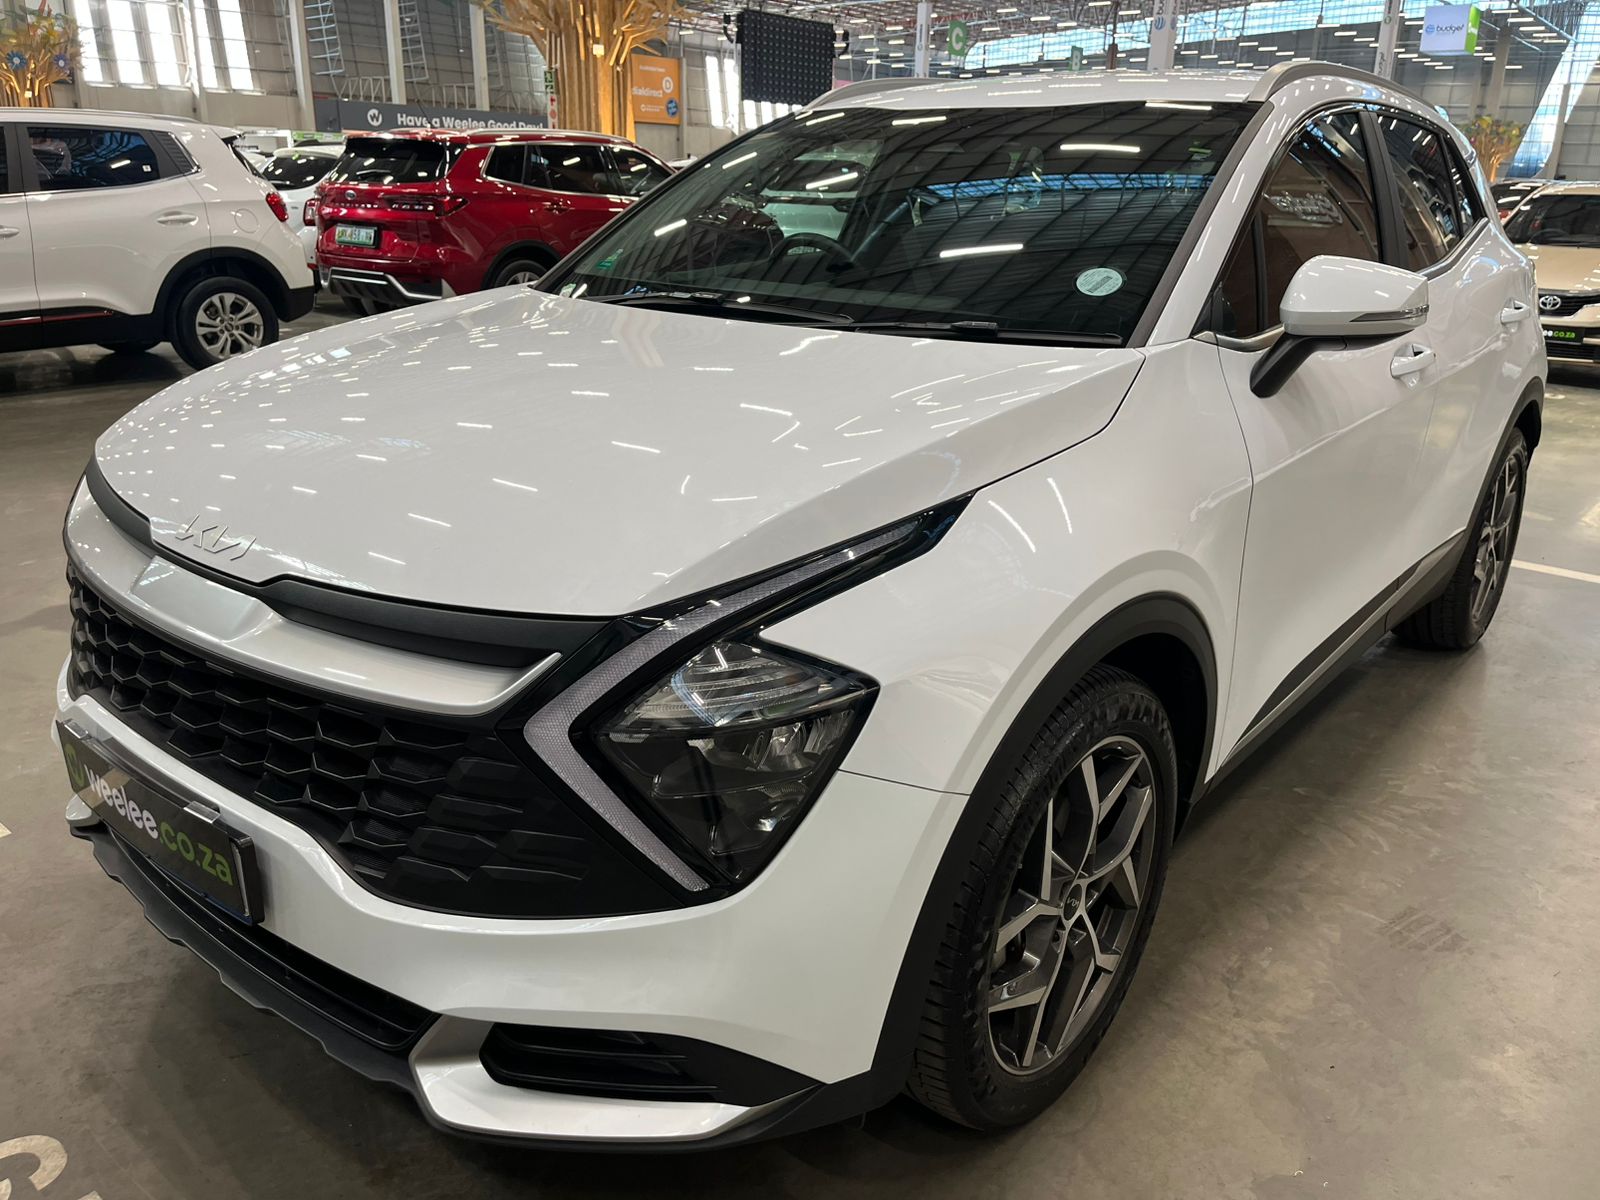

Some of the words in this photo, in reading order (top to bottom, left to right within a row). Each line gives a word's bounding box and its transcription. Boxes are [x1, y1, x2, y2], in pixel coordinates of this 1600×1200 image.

[952, 26, 963, 49] C
[1436, 24, 1464, 34] budget
[1072, 50, 1080, 67] B
[397, 113, 429, 127] Have
[442, 116, 485, 129] Weelee
[487, 119, 516, 129] Good
[175, 513, 257, 562] KIA
[84, 764, 233, 886] weelee.co.za
